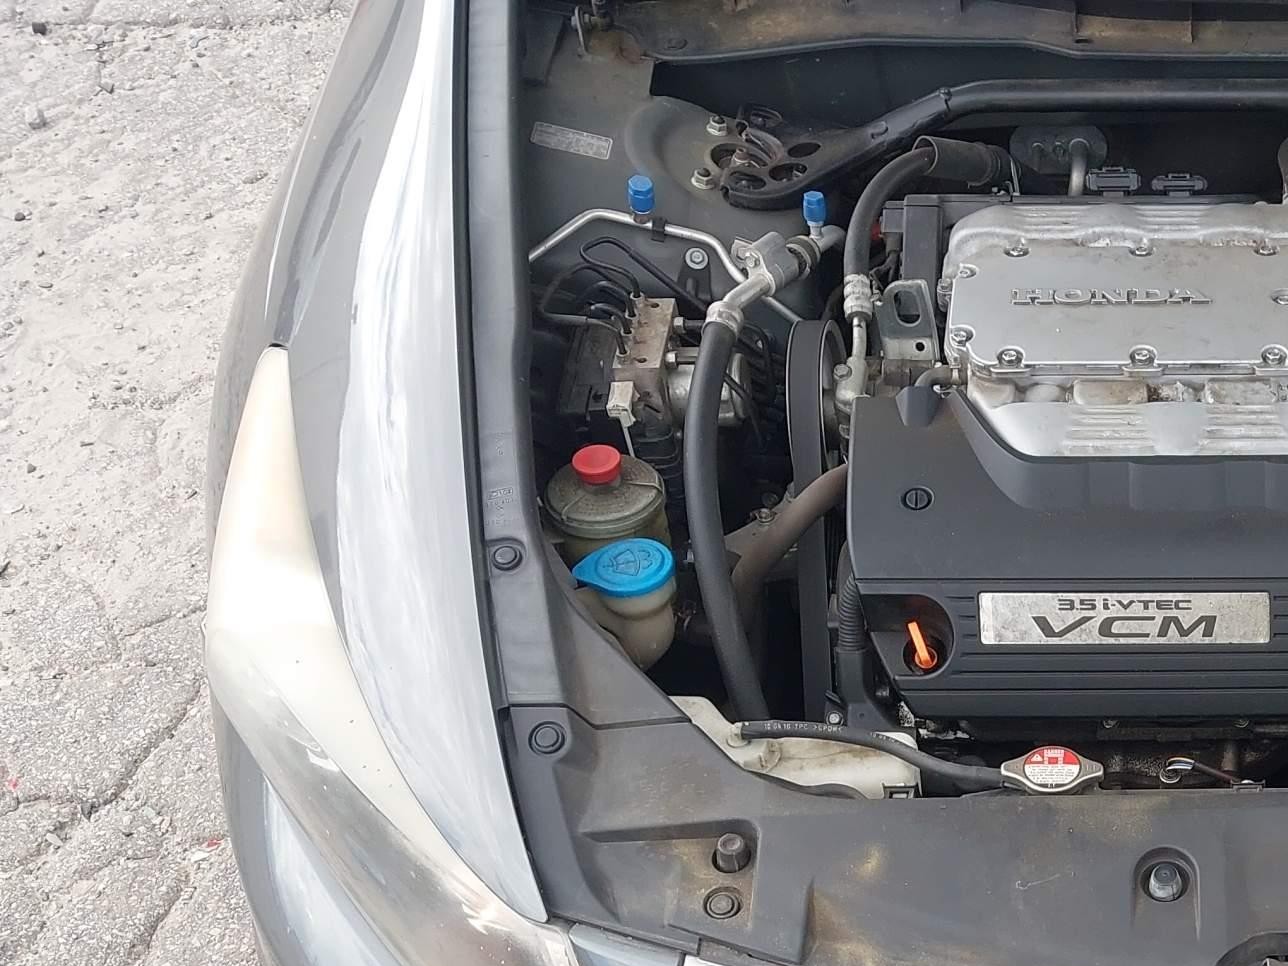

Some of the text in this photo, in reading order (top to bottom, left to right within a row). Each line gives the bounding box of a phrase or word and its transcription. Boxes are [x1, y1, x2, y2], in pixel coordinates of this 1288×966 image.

[1011, 287, 1212, 305] HONDA
[1057, 597, 1192, 611] 3.5 i-VTEC
[1031, 615, 1218, 639] VCM
